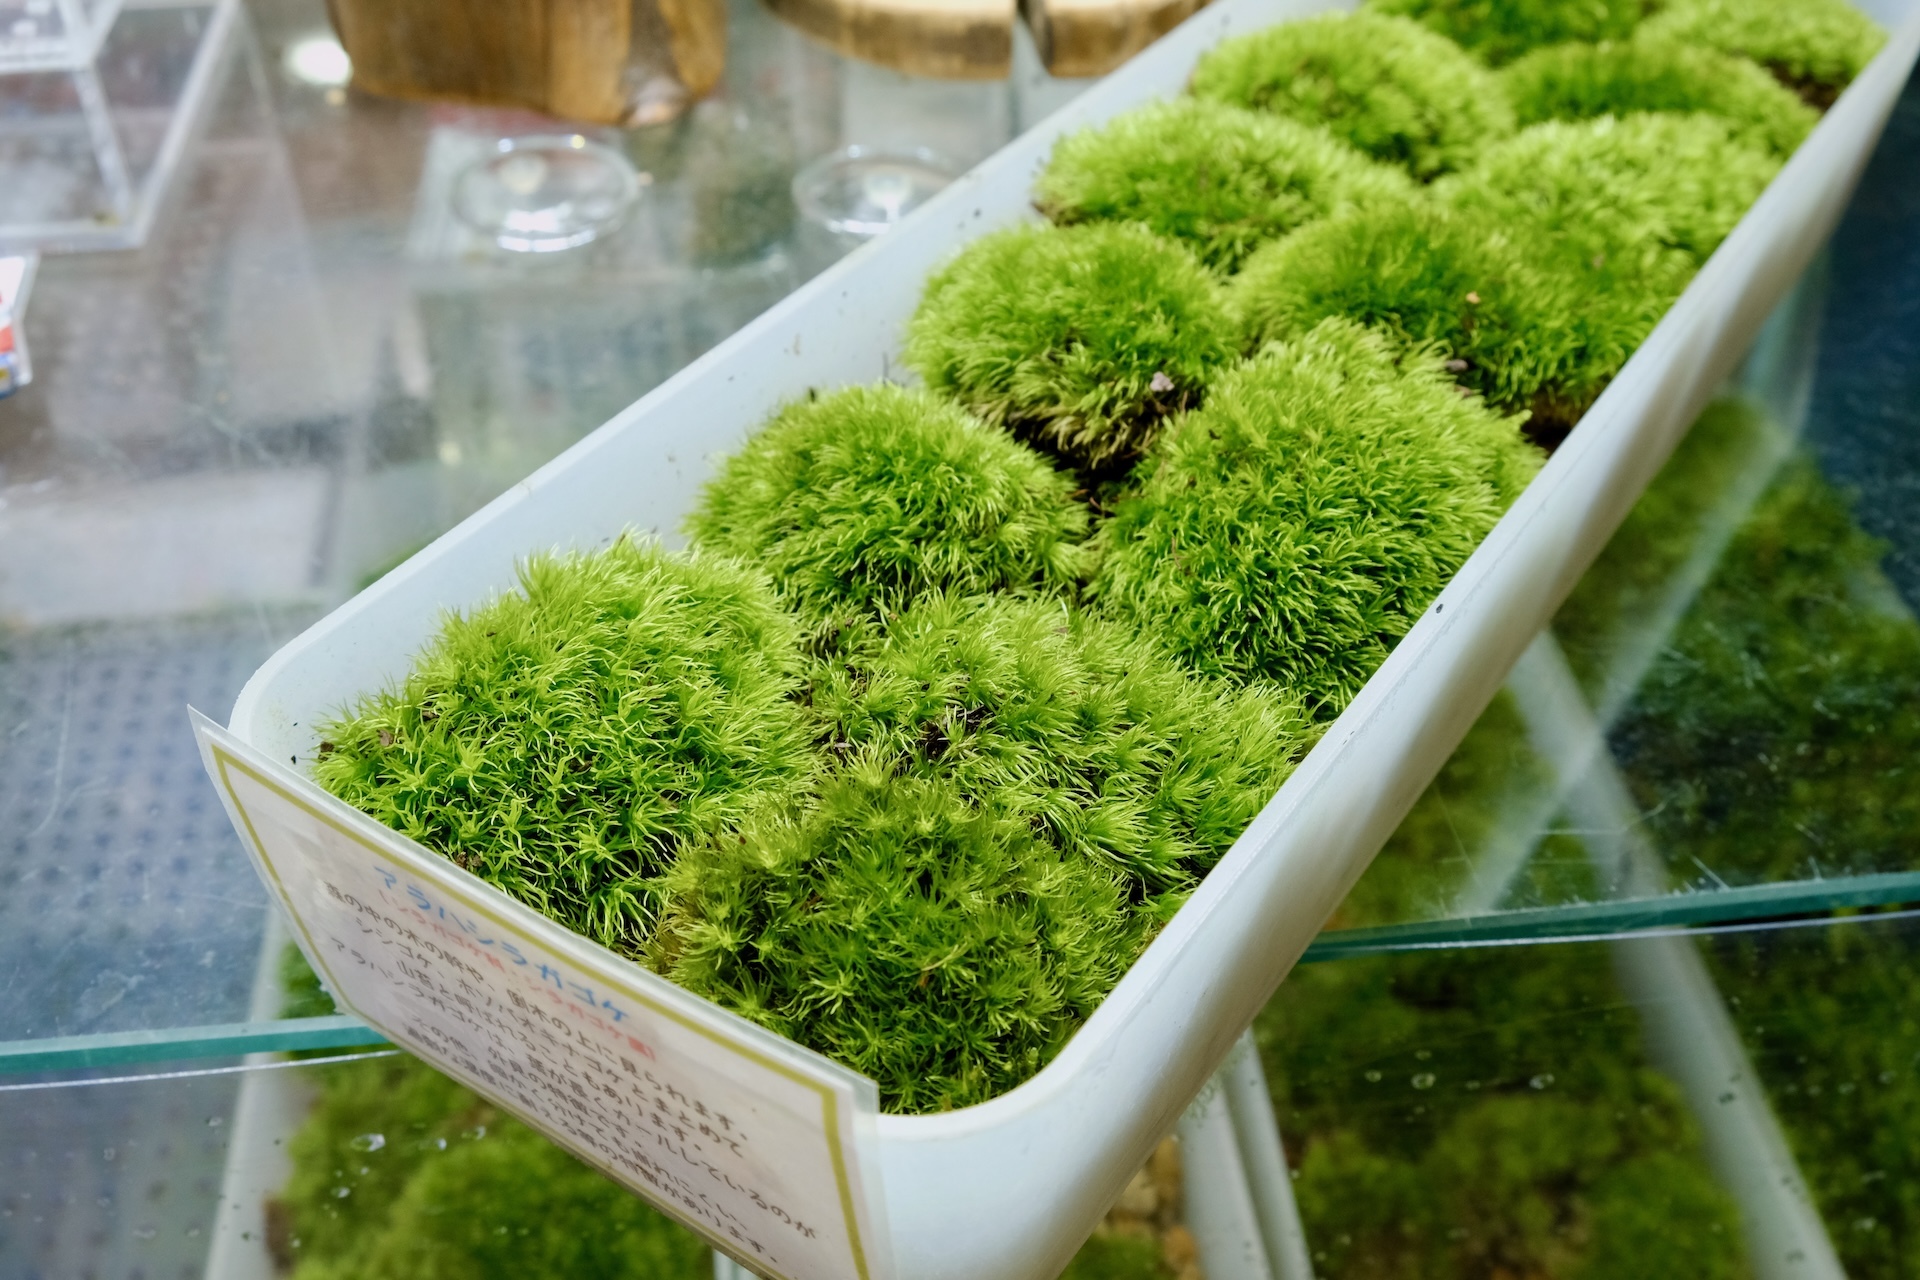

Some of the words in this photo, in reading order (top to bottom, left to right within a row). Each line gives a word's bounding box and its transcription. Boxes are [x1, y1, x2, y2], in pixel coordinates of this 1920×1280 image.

[374, 866, 630, 1022] アラハシラガゴケ
[331, 936, 817, 1239] アラハシラガゴケは、葉が長くカールしているのが
[396, 960, 703, 1152] 山苔と呼ばれることもあります。
[487, 1045, 643, 1149] 外見の特徴です。
